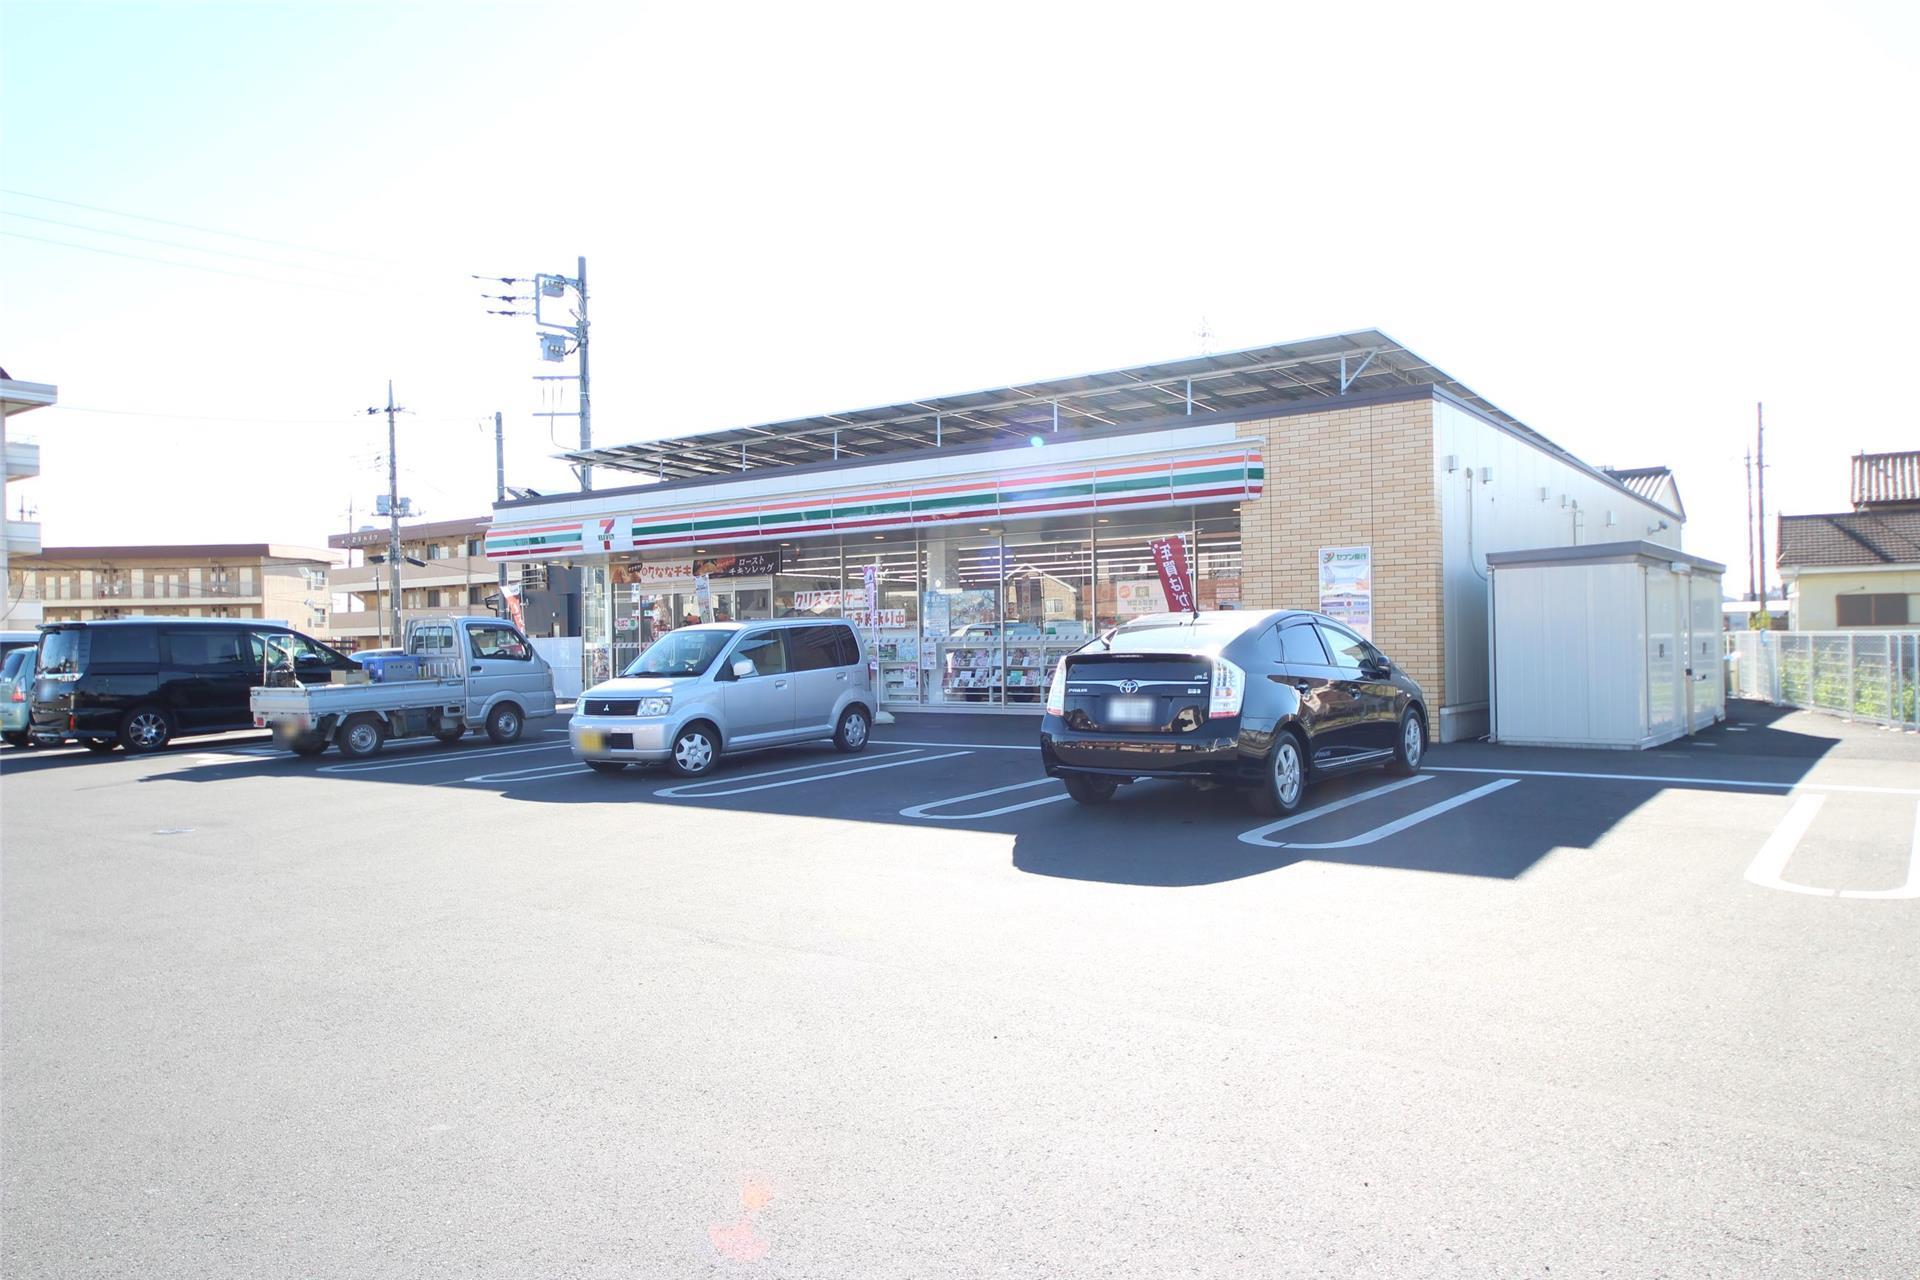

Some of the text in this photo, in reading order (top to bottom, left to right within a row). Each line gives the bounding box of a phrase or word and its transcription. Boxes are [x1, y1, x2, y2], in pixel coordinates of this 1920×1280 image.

[738, 556, 764, 566] ロースト
[728, 563, 775, 576] チキンレッグ
[796, 590, 869, 608] クリスマスケー
